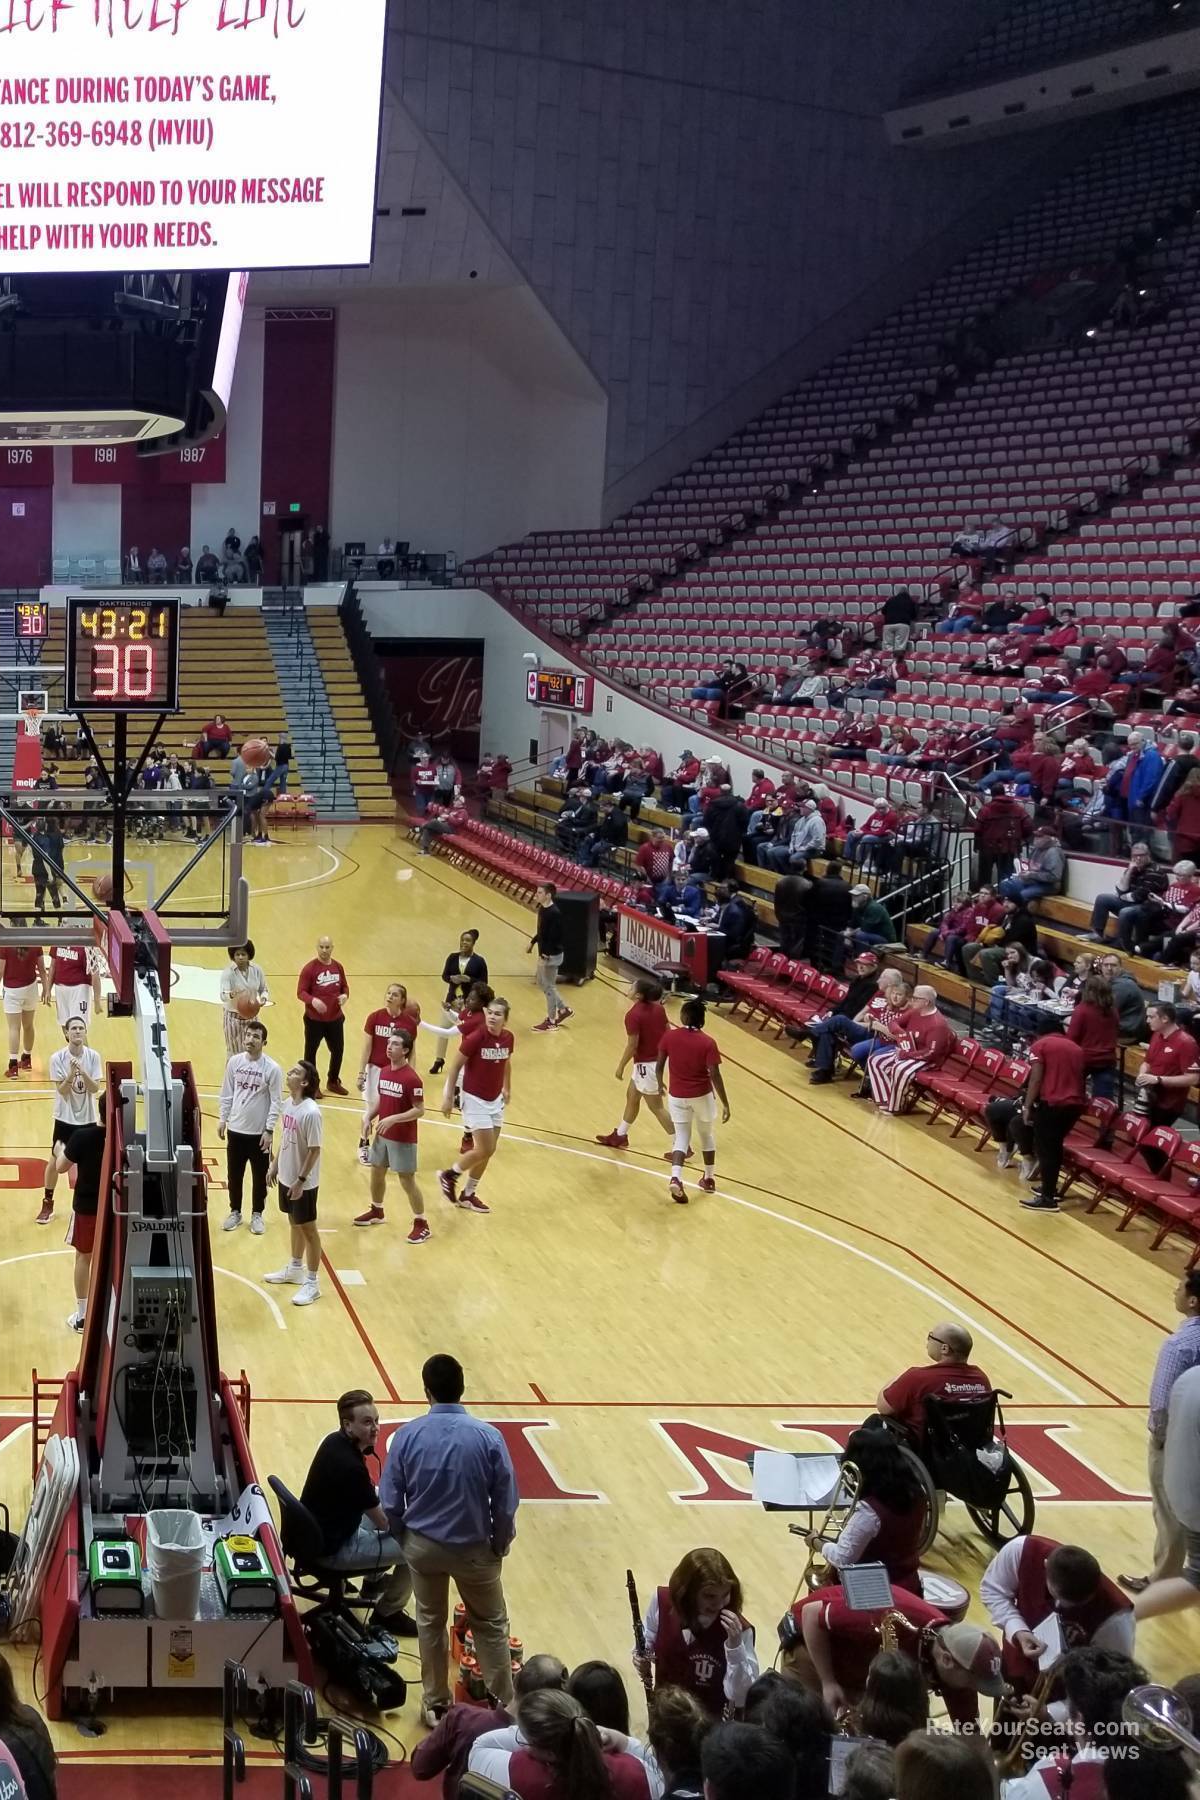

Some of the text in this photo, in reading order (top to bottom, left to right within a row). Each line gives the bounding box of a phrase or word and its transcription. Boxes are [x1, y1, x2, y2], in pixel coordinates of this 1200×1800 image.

[56, 77, 128, 103] DURING
[134, 76, 213, 102] TODAY'S
[220, 75, 276, 104] GAME,
[0, 120, 142, 148] 812-369-6948
[149, 118, 213, 151] (MYIU)
[19, 183, 62, 208] WILL
[68, 181, 155, 207] RESPOND
[160, 180, 182, 205] TO
[188, 179, 236, 205] YOUR
[242, 177, 324, 203] MESSAGE
[46, 224, 93, 249] WITH
[99, 223, 148, 248] YOUR
[154, 221, 217, 247] NEEDS.
[8, 449, 32, 464] 1976
[95, 448, 116, 463] 1981
[180, 448, 205, 463] 1987
[17, 604, 46, 616] 43:21
[21, 616, 42, 634] 30
[80, 609, 165, 640] 43:21
[93, 644, 153, 696] 30
[626, 917, 673, 962] INDIANA
[132, 1221, 185, 1233] SPALDING
[951, 1383, 986, 1392] Smithville
